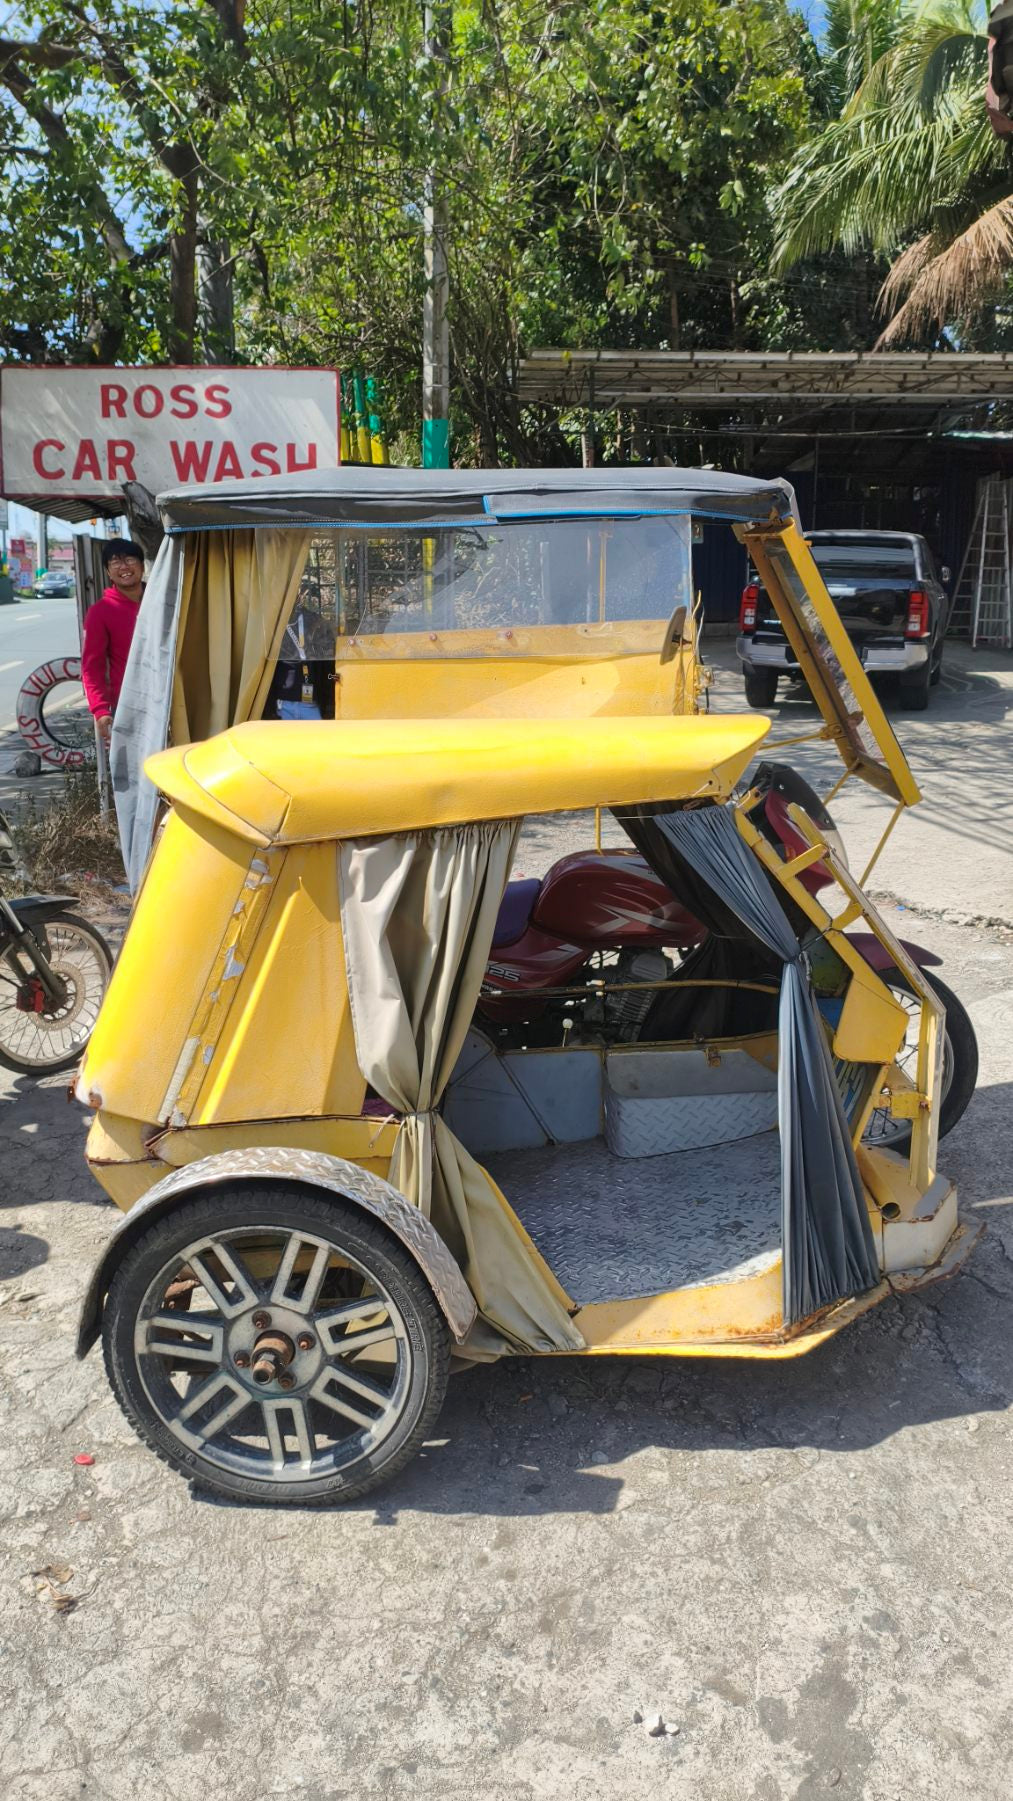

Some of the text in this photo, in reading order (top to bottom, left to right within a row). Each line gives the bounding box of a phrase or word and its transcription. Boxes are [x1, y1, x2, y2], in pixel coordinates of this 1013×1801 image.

[100, 384, 233, 419] ROSS
[33, 439, 318, 483] CAR WASH
[21, 659, 82, 697] VULC
[18, 715, 85, 765] SHOP
